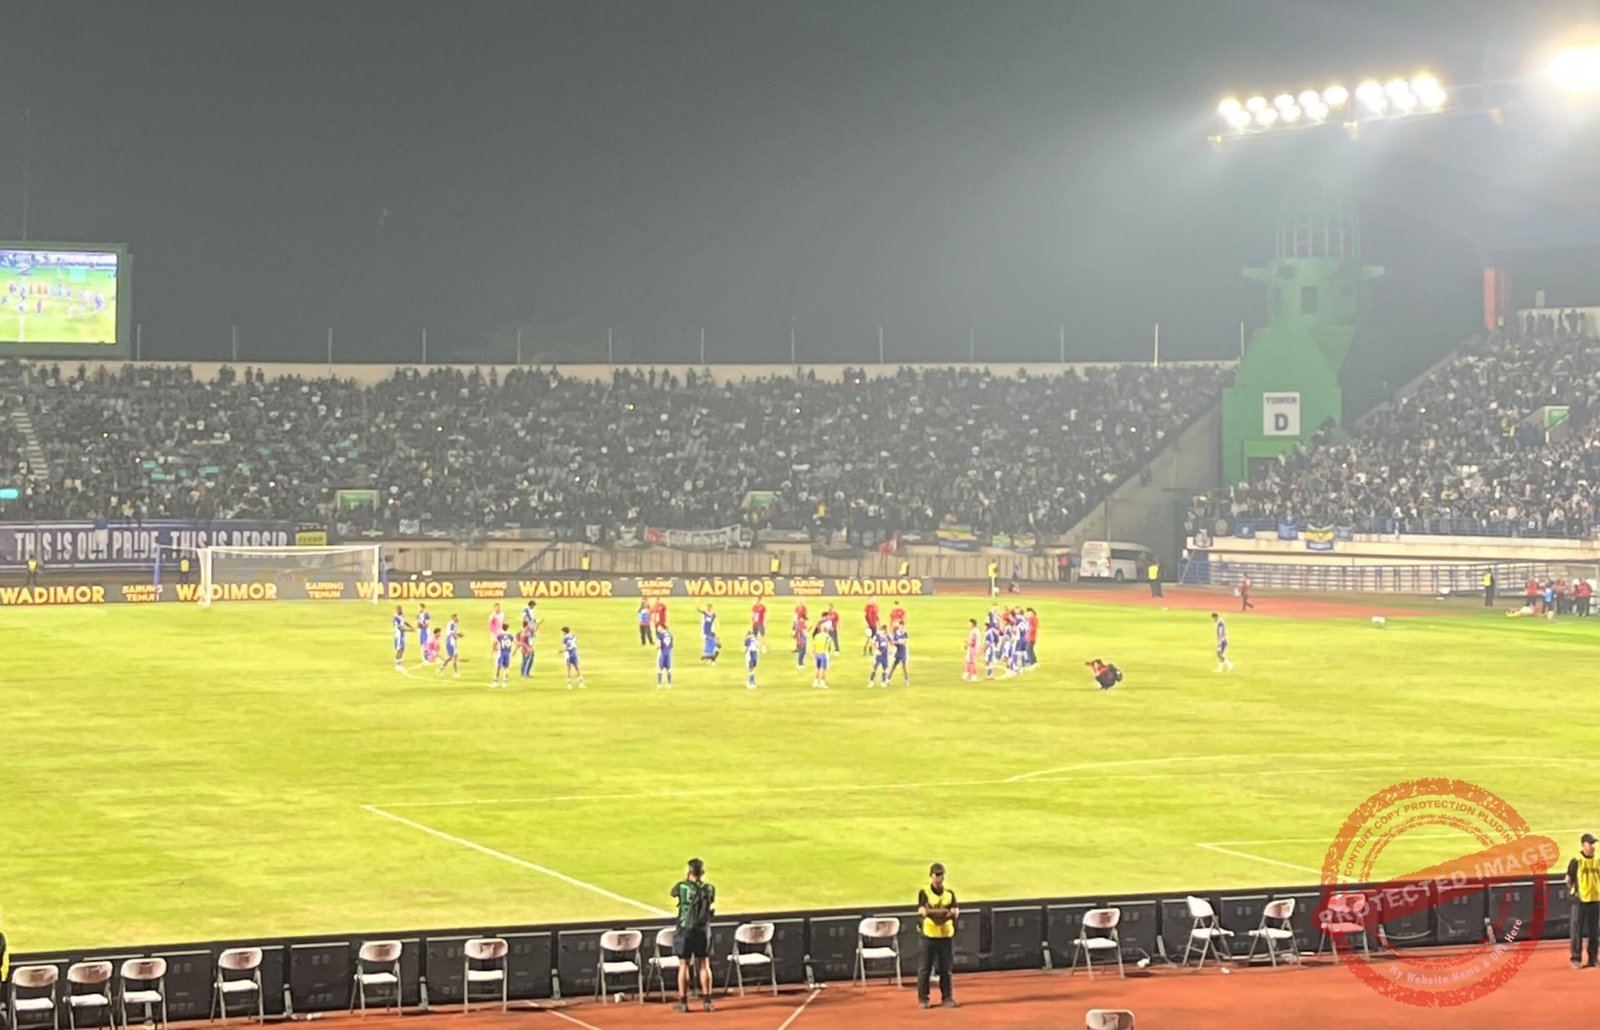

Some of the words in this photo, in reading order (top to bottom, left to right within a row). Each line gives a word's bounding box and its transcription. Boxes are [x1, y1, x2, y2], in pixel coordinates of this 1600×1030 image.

[1265, 396, 1298, 405] TOWER
[1274, 413, 1289, 431] D
[14, 531, 52, 560] THIS
[57, 531, 73, 560] IS
[170, 530, 208, 559] THIS
[0, 585, 105, 605] WADIMOR
[175, 582, 278, 601] WADIMOR
[518, 580, 613, 597] WADIMOR
[684, 579, 776, 597] WADIMOR
[834, 579, 922, 595] WADIMOR
